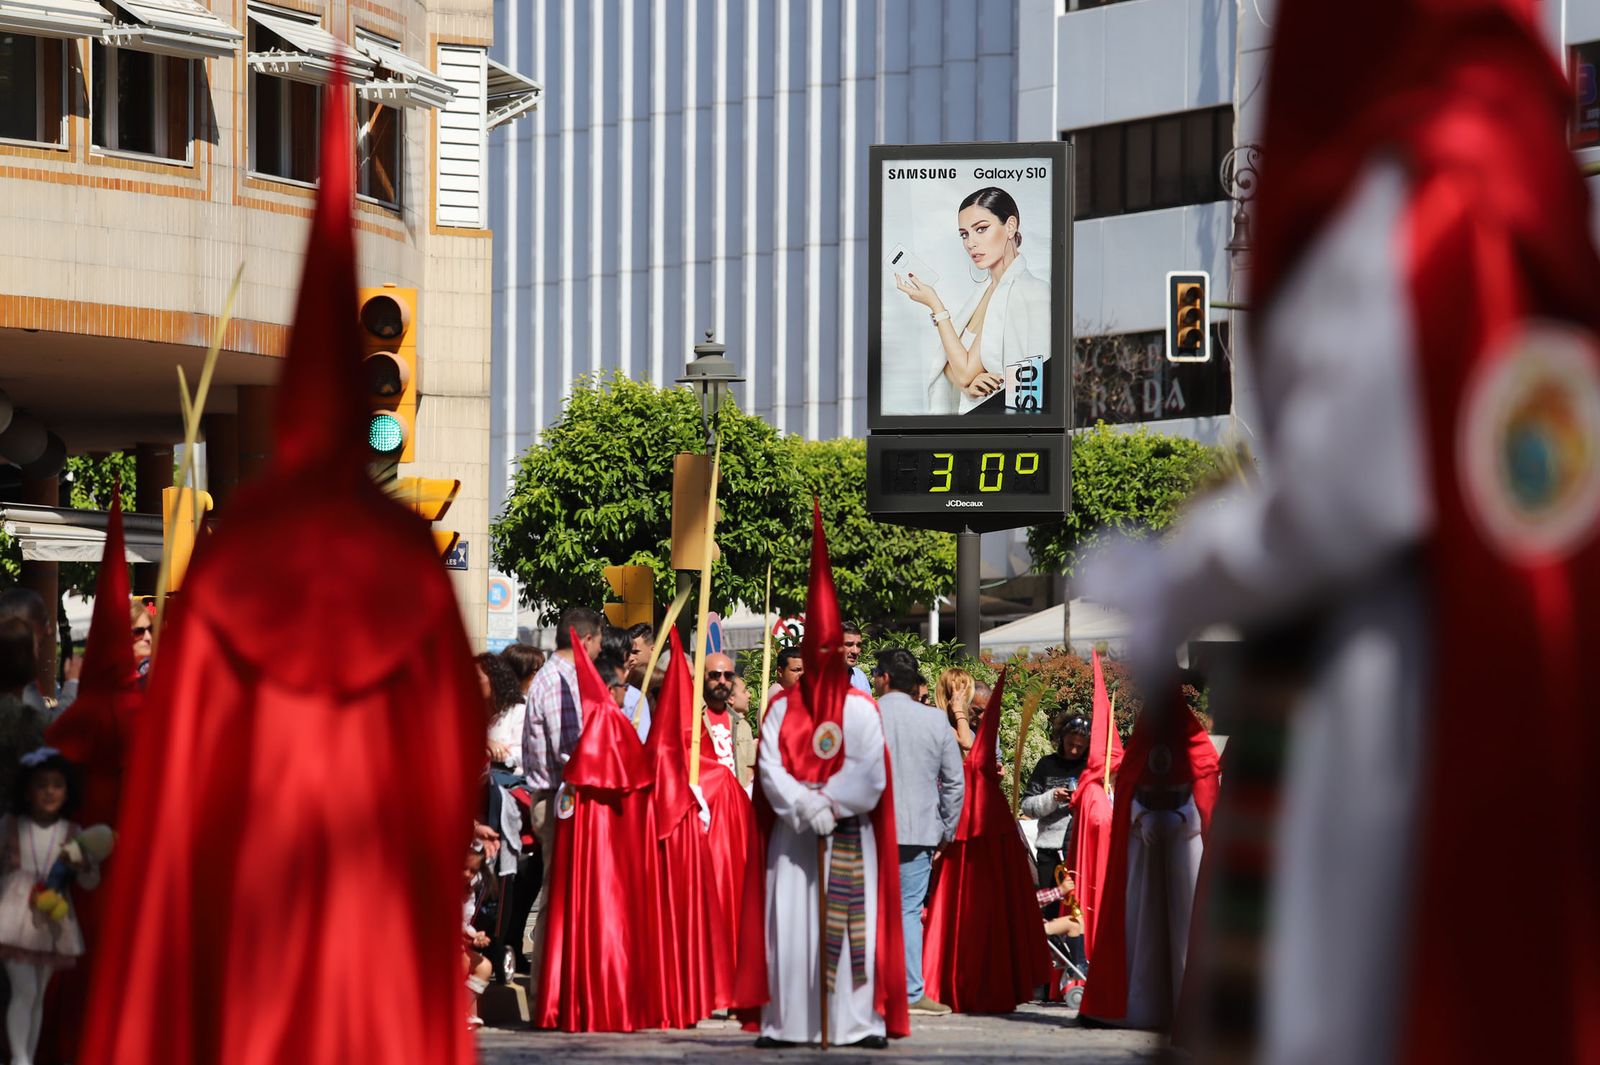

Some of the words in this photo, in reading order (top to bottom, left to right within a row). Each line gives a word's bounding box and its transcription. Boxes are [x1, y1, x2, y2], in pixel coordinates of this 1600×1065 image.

[888, 168, 957, 180] SAMSUNG
[973, 167, 1024, 182] Galaxy
[1026, 167, 1047, 179] S10
[1015, 366, 1038, 411] S10
[945, 500, 984, 508] JCDecaux
